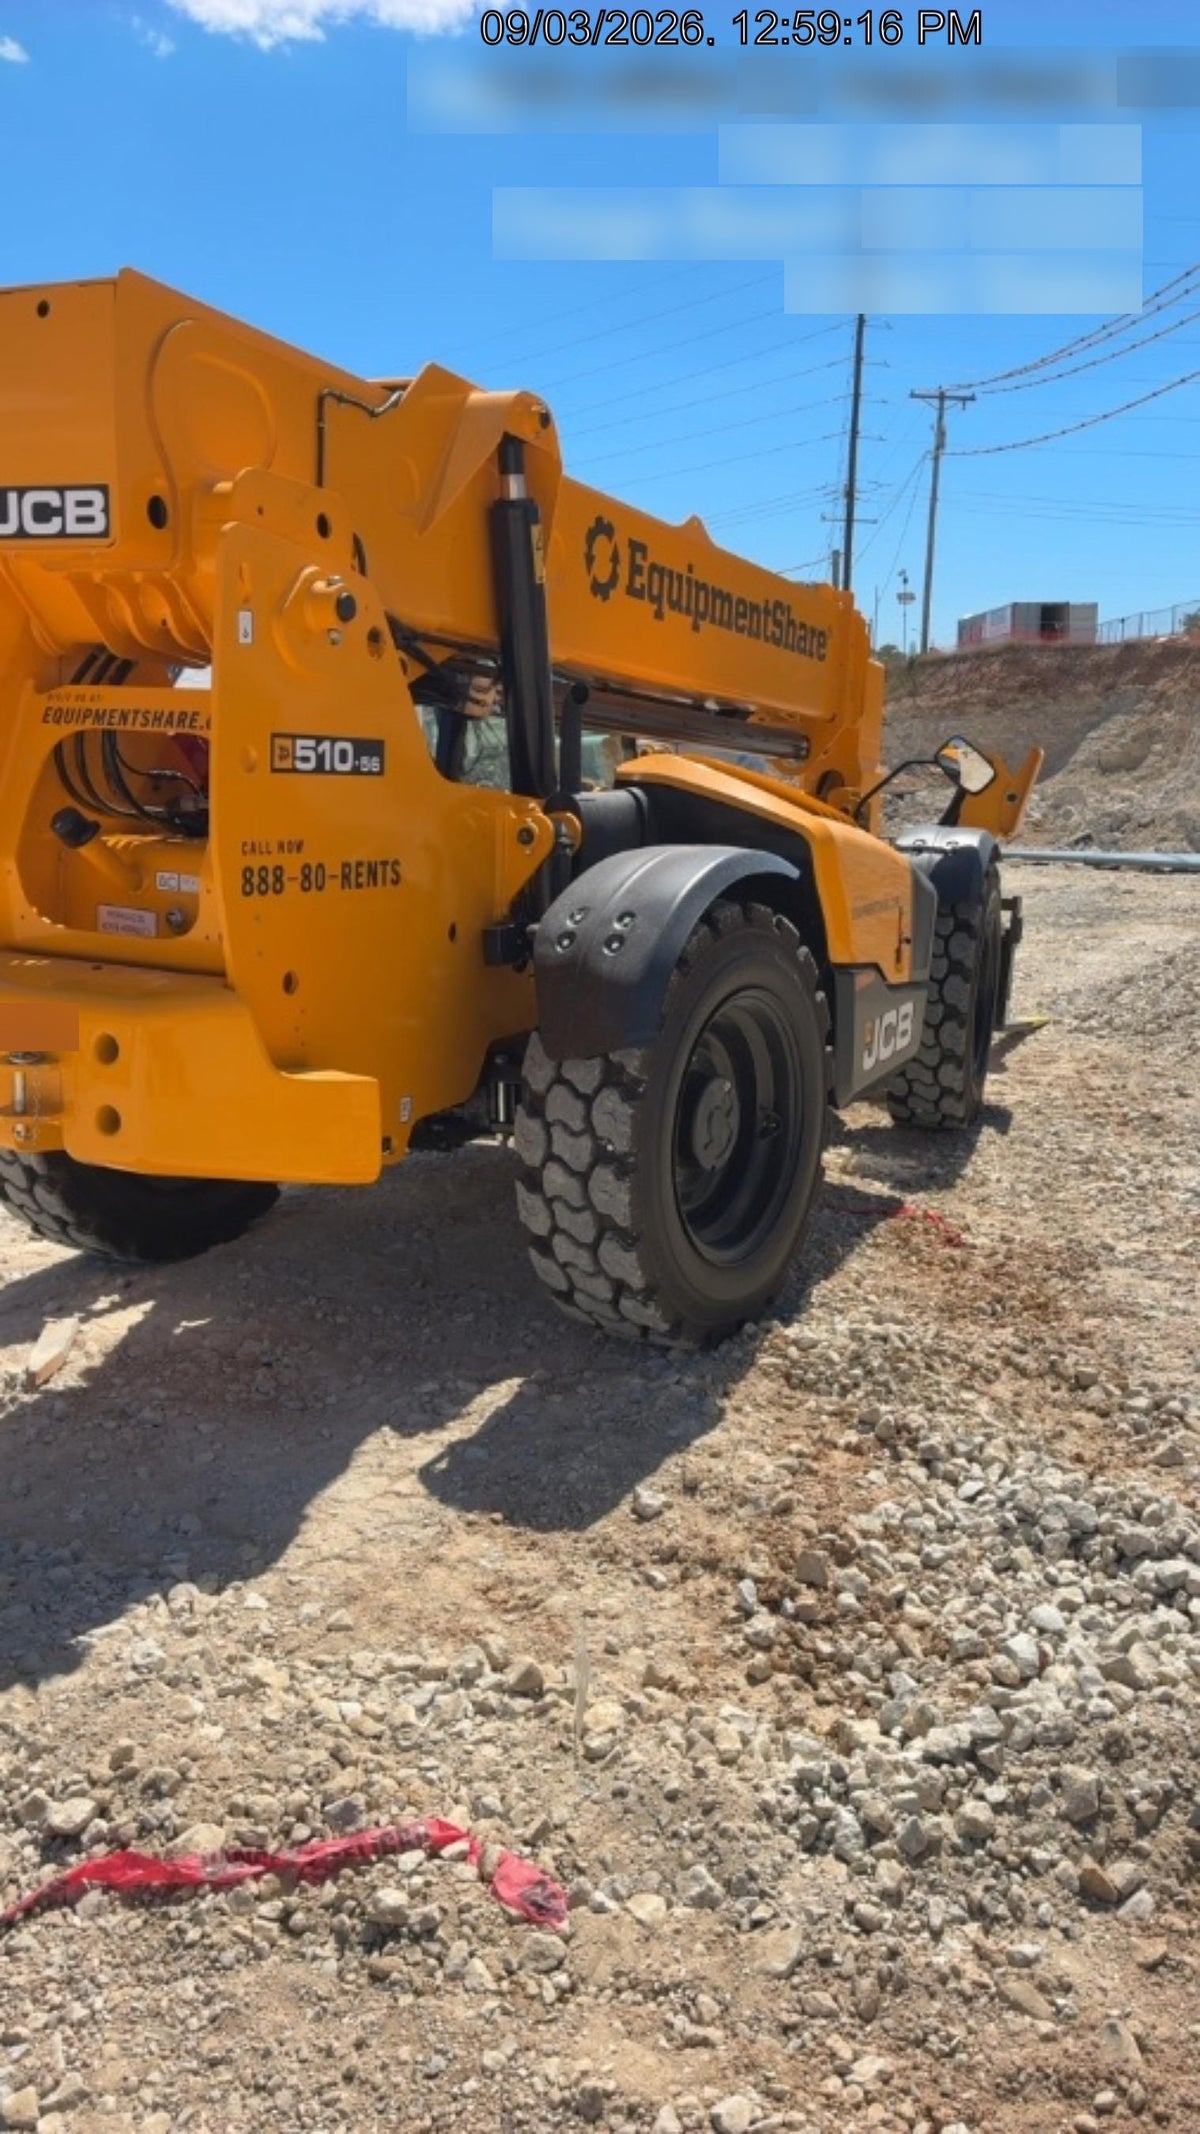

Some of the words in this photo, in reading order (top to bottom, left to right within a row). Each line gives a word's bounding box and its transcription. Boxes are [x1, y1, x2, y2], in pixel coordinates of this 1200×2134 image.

[0, 489, 106, 535] JCB
[626, 537, 827, 663] EquipmentShare
[241, 841, 272, 857] CALL
[277, 839, 305, 855] NOW
[241, 858, 402, 897] 888-80-RENTS
[862, 1002, 915, 1071] JCB
